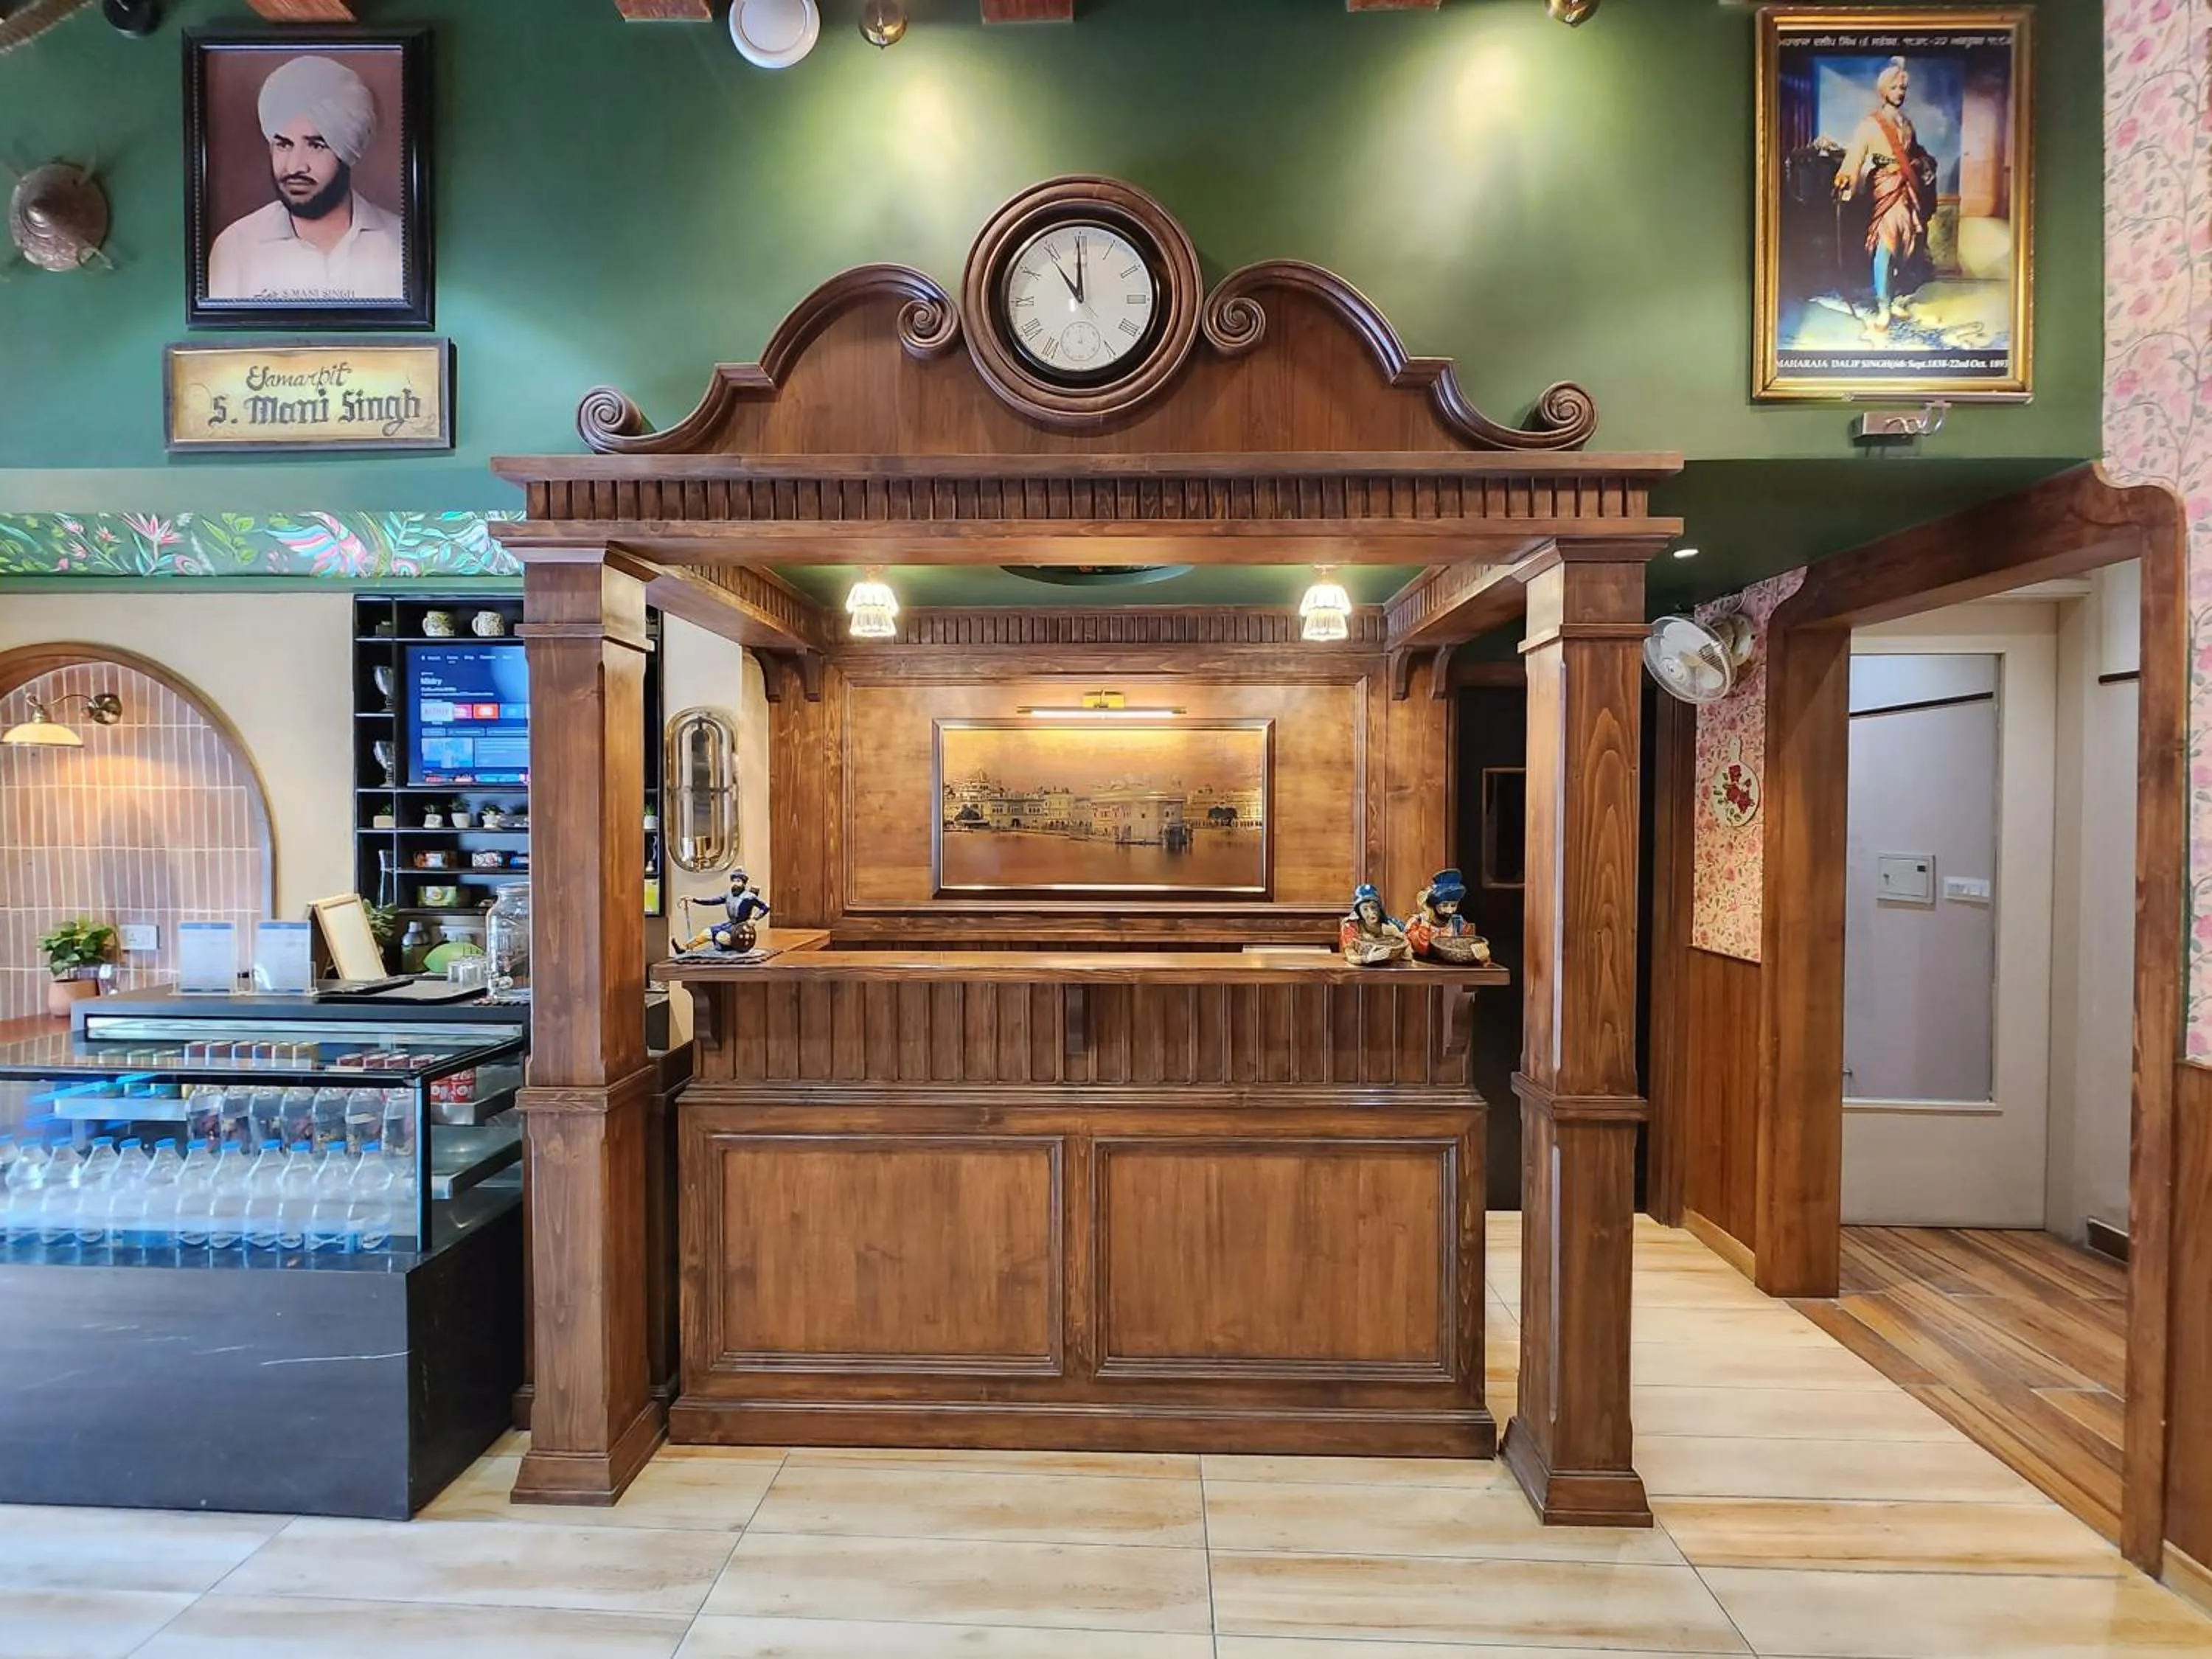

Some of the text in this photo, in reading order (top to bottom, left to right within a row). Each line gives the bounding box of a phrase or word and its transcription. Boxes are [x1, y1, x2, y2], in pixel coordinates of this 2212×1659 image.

[208, 386, 422, 437] S. Mani Singh
